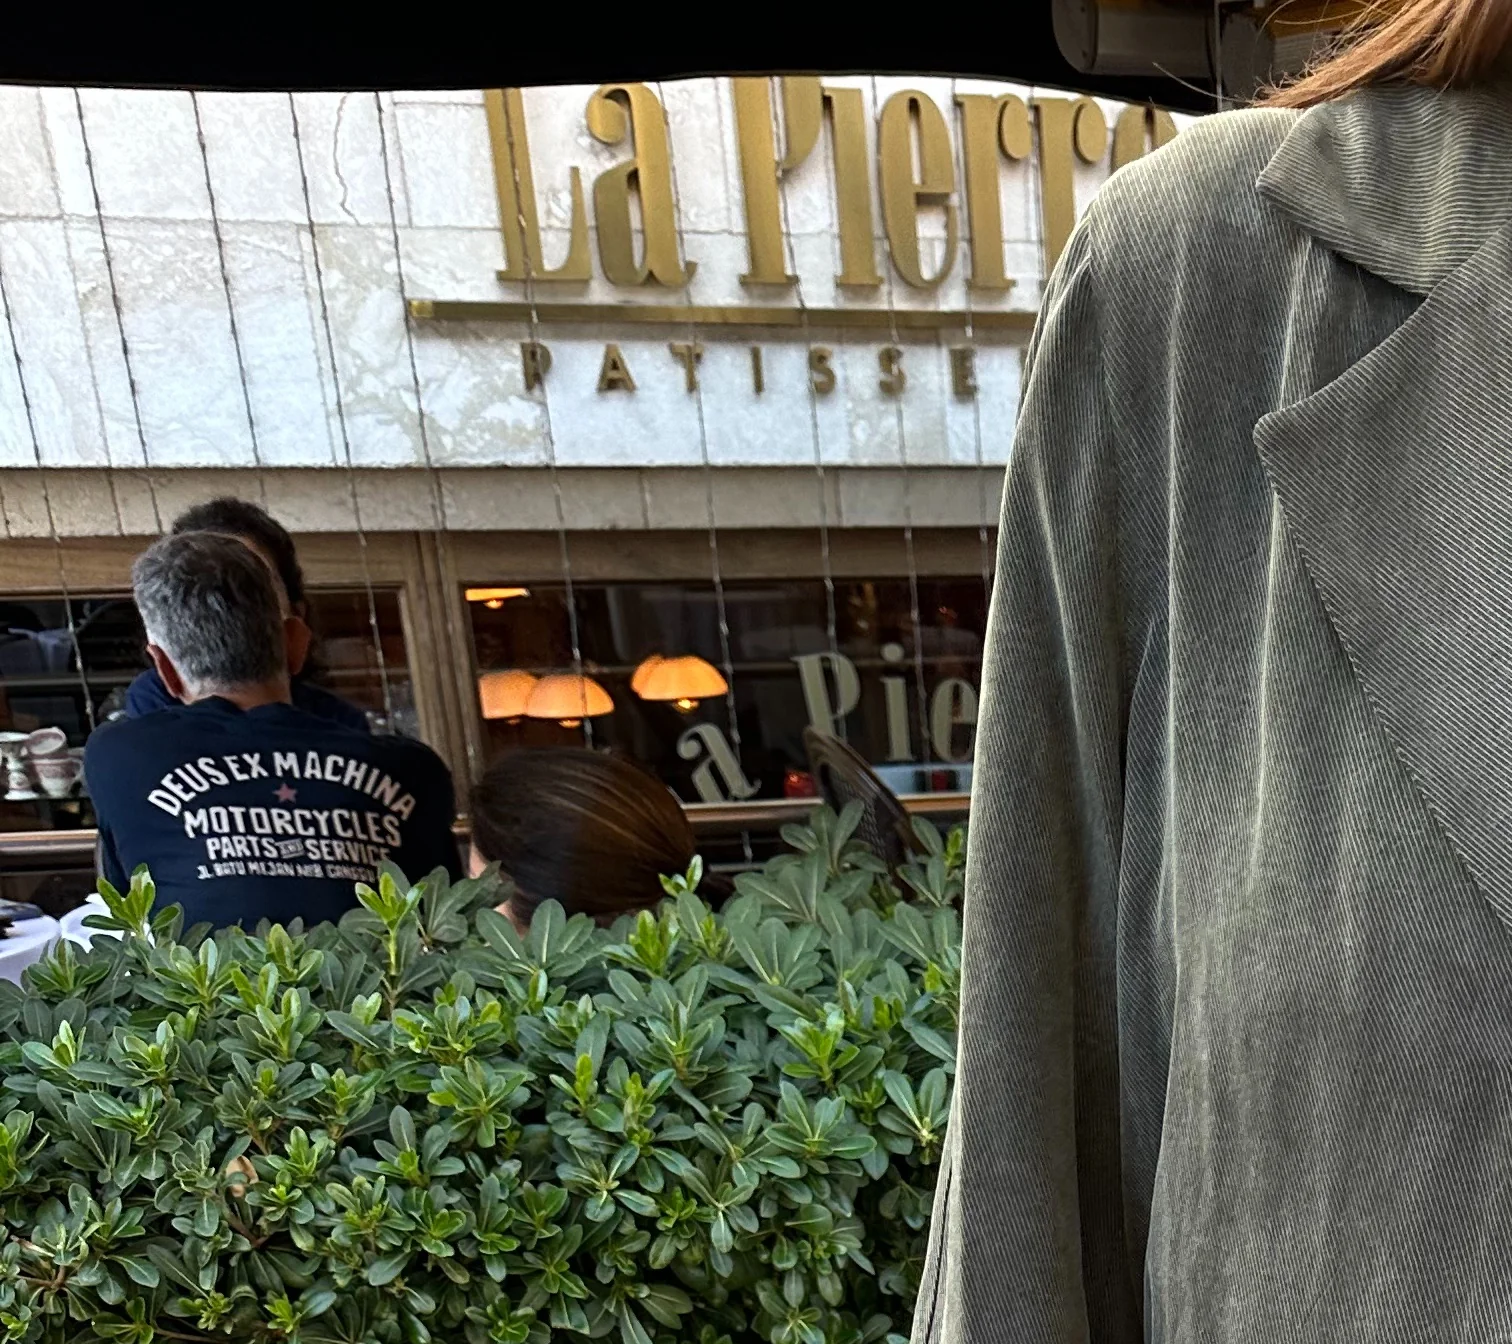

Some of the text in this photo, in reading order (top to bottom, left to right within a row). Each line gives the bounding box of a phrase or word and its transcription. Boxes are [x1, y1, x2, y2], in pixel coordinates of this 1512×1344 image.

[483, 86, 696, 288] La
[521, 342, 1022, 397] PATISSE
[148, 750, 417, 822] DEUS EX MACHINA
[183, 805, 402, 848] MOTORCYCLES
[206, 835, 279, 861] PARTS
